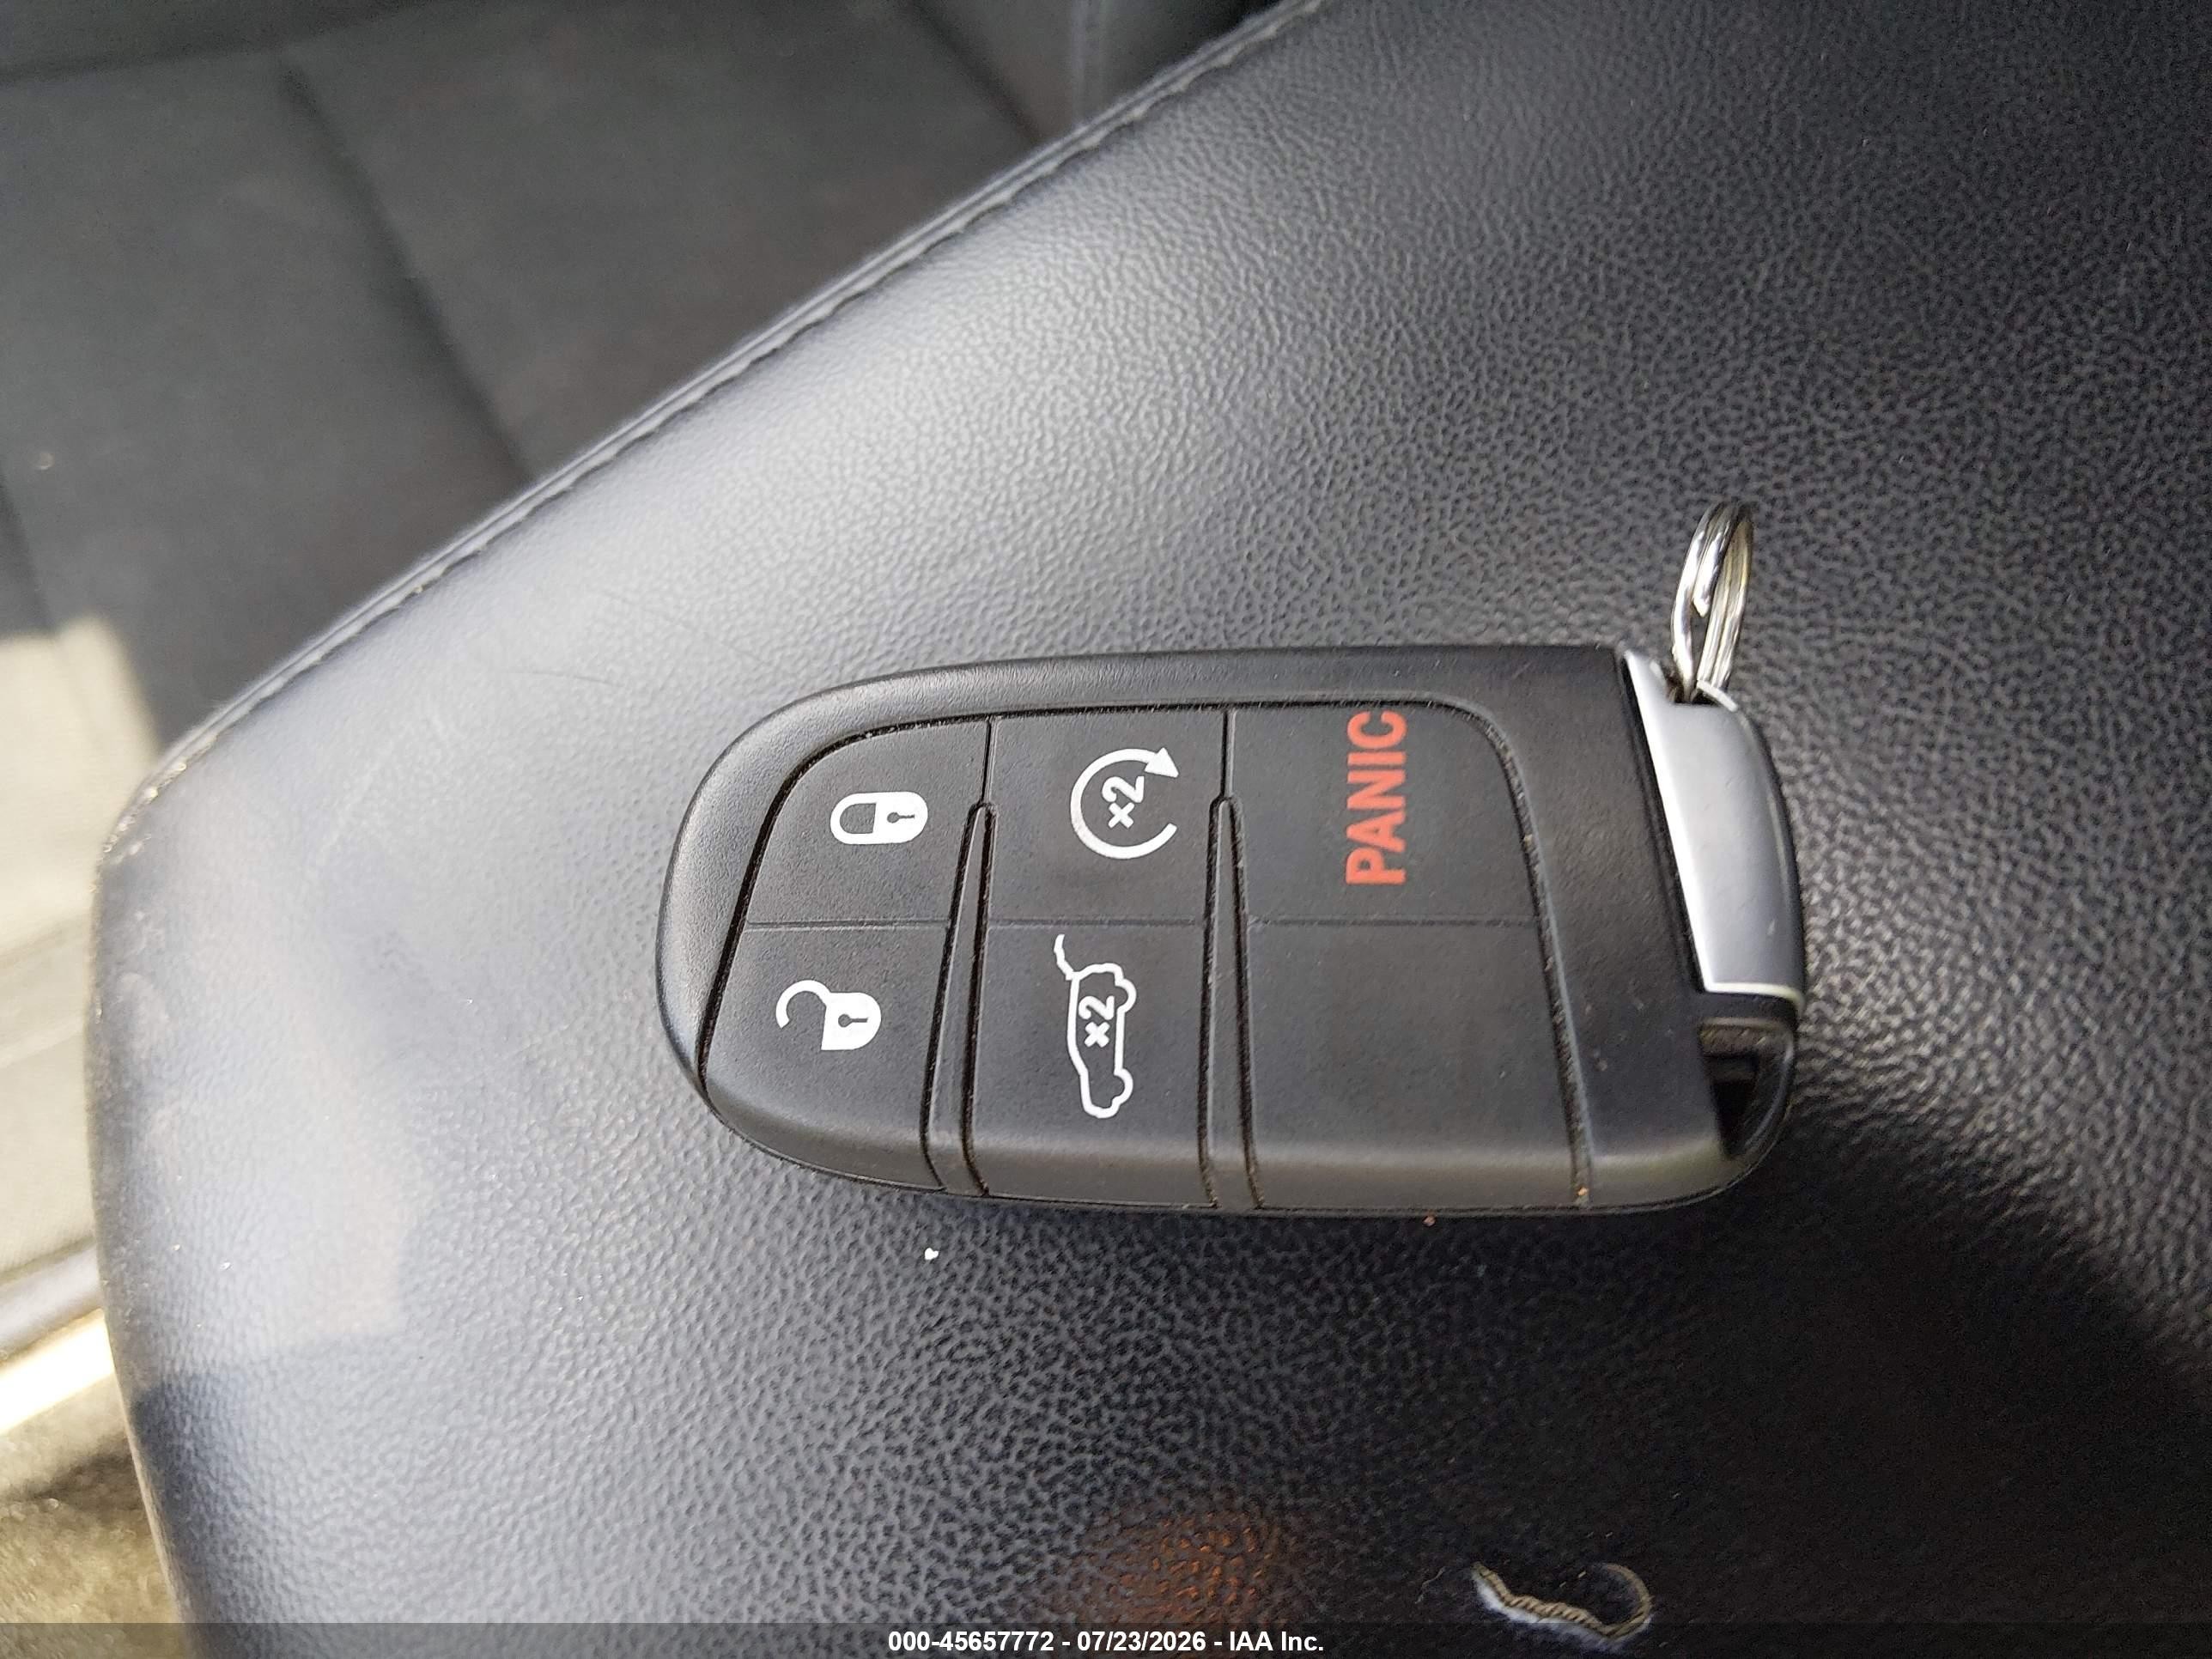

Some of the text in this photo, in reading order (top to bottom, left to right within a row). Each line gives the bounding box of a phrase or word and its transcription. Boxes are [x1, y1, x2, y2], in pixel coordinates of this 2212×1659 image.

[1101, 775, 1146, 829] x2
[1346, 710, 1407, 884] PANIC
[1078, 994, 1115, 1048] x2
